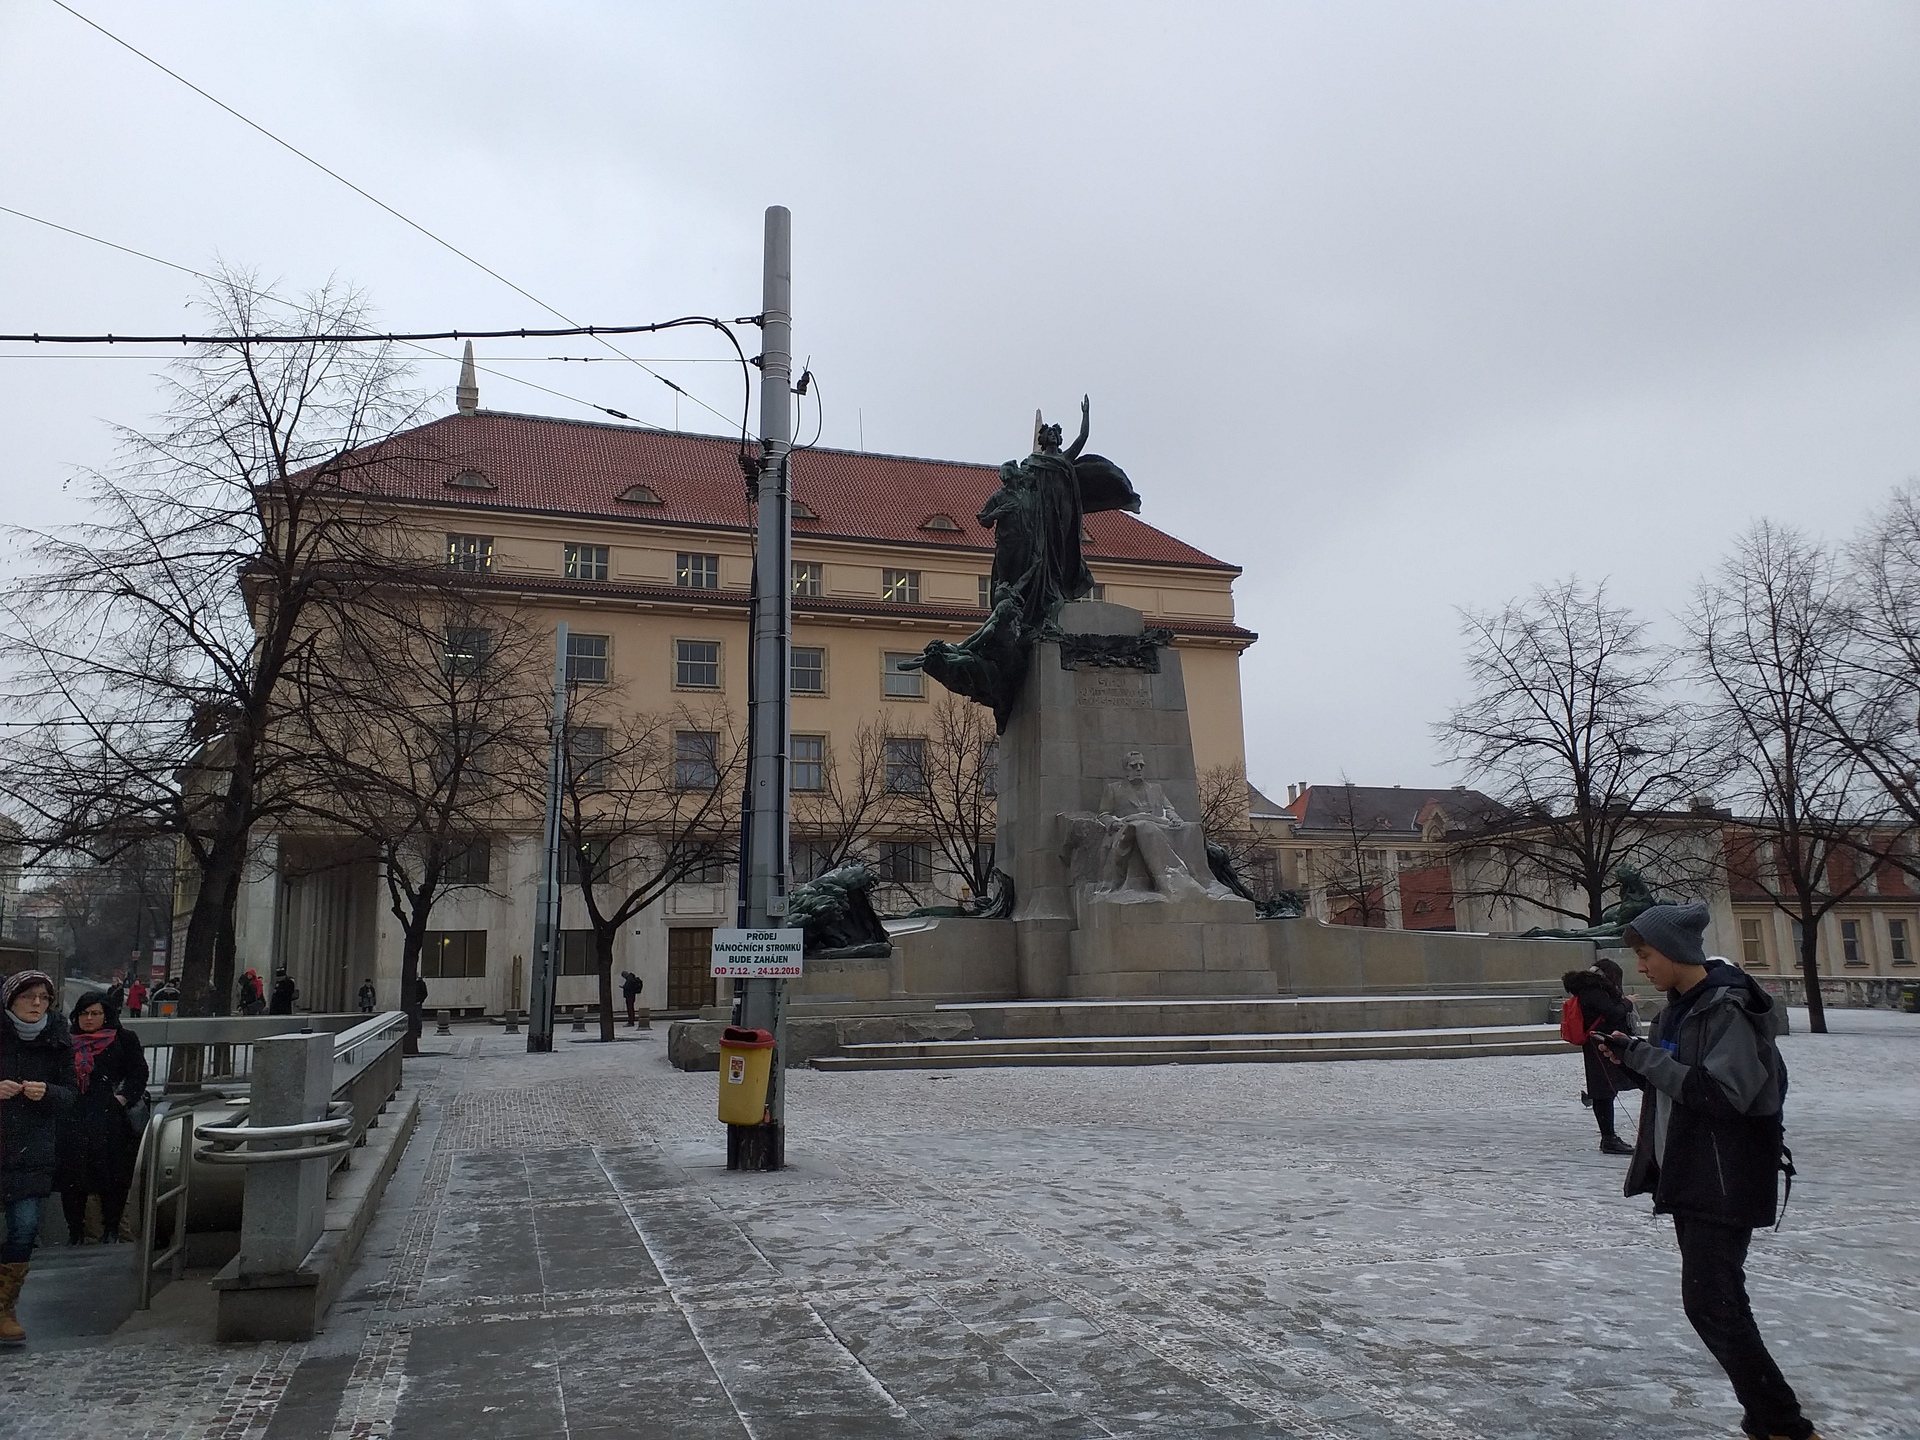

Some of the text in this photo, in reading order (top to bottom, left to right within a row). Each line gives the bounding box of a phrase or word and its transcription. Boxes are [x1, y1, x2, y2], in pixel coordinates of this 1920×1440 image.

[746, 932, 777, 941] PRODEJ
[714, 942, 763, 952] VÁNOČNÍCH
[728, 954, 789, 964] BUDE ZAHÁJEN
[714, 967, 727, 975] OD
[729, 967, 750, 975] 7.12.
[757, 967, 800, 975] 24.12.2018
